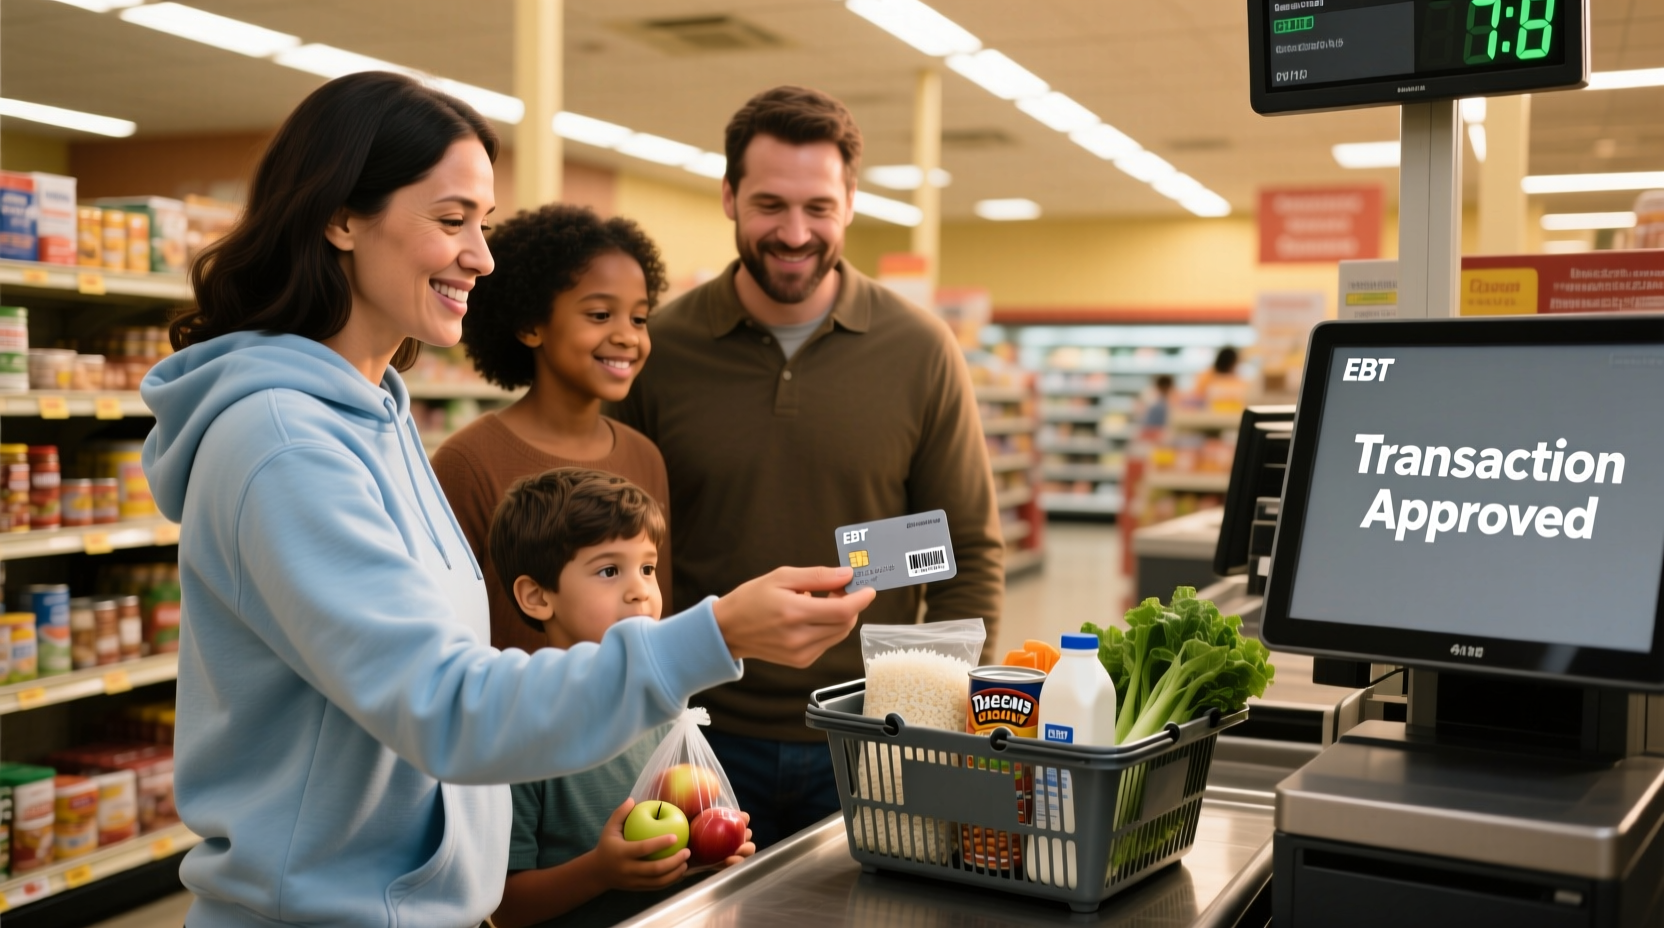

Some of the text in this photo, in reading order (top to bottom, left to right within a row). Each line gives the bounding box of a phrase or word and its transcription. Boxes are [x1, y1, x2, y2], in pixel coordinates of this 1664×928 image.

[1343, 358, 1396, 382] EBT
[1355, 433, 1626, 484] Transaction
[1360, 488, 1599, 543] Approved
[843, 528, 869, 545] EBT
